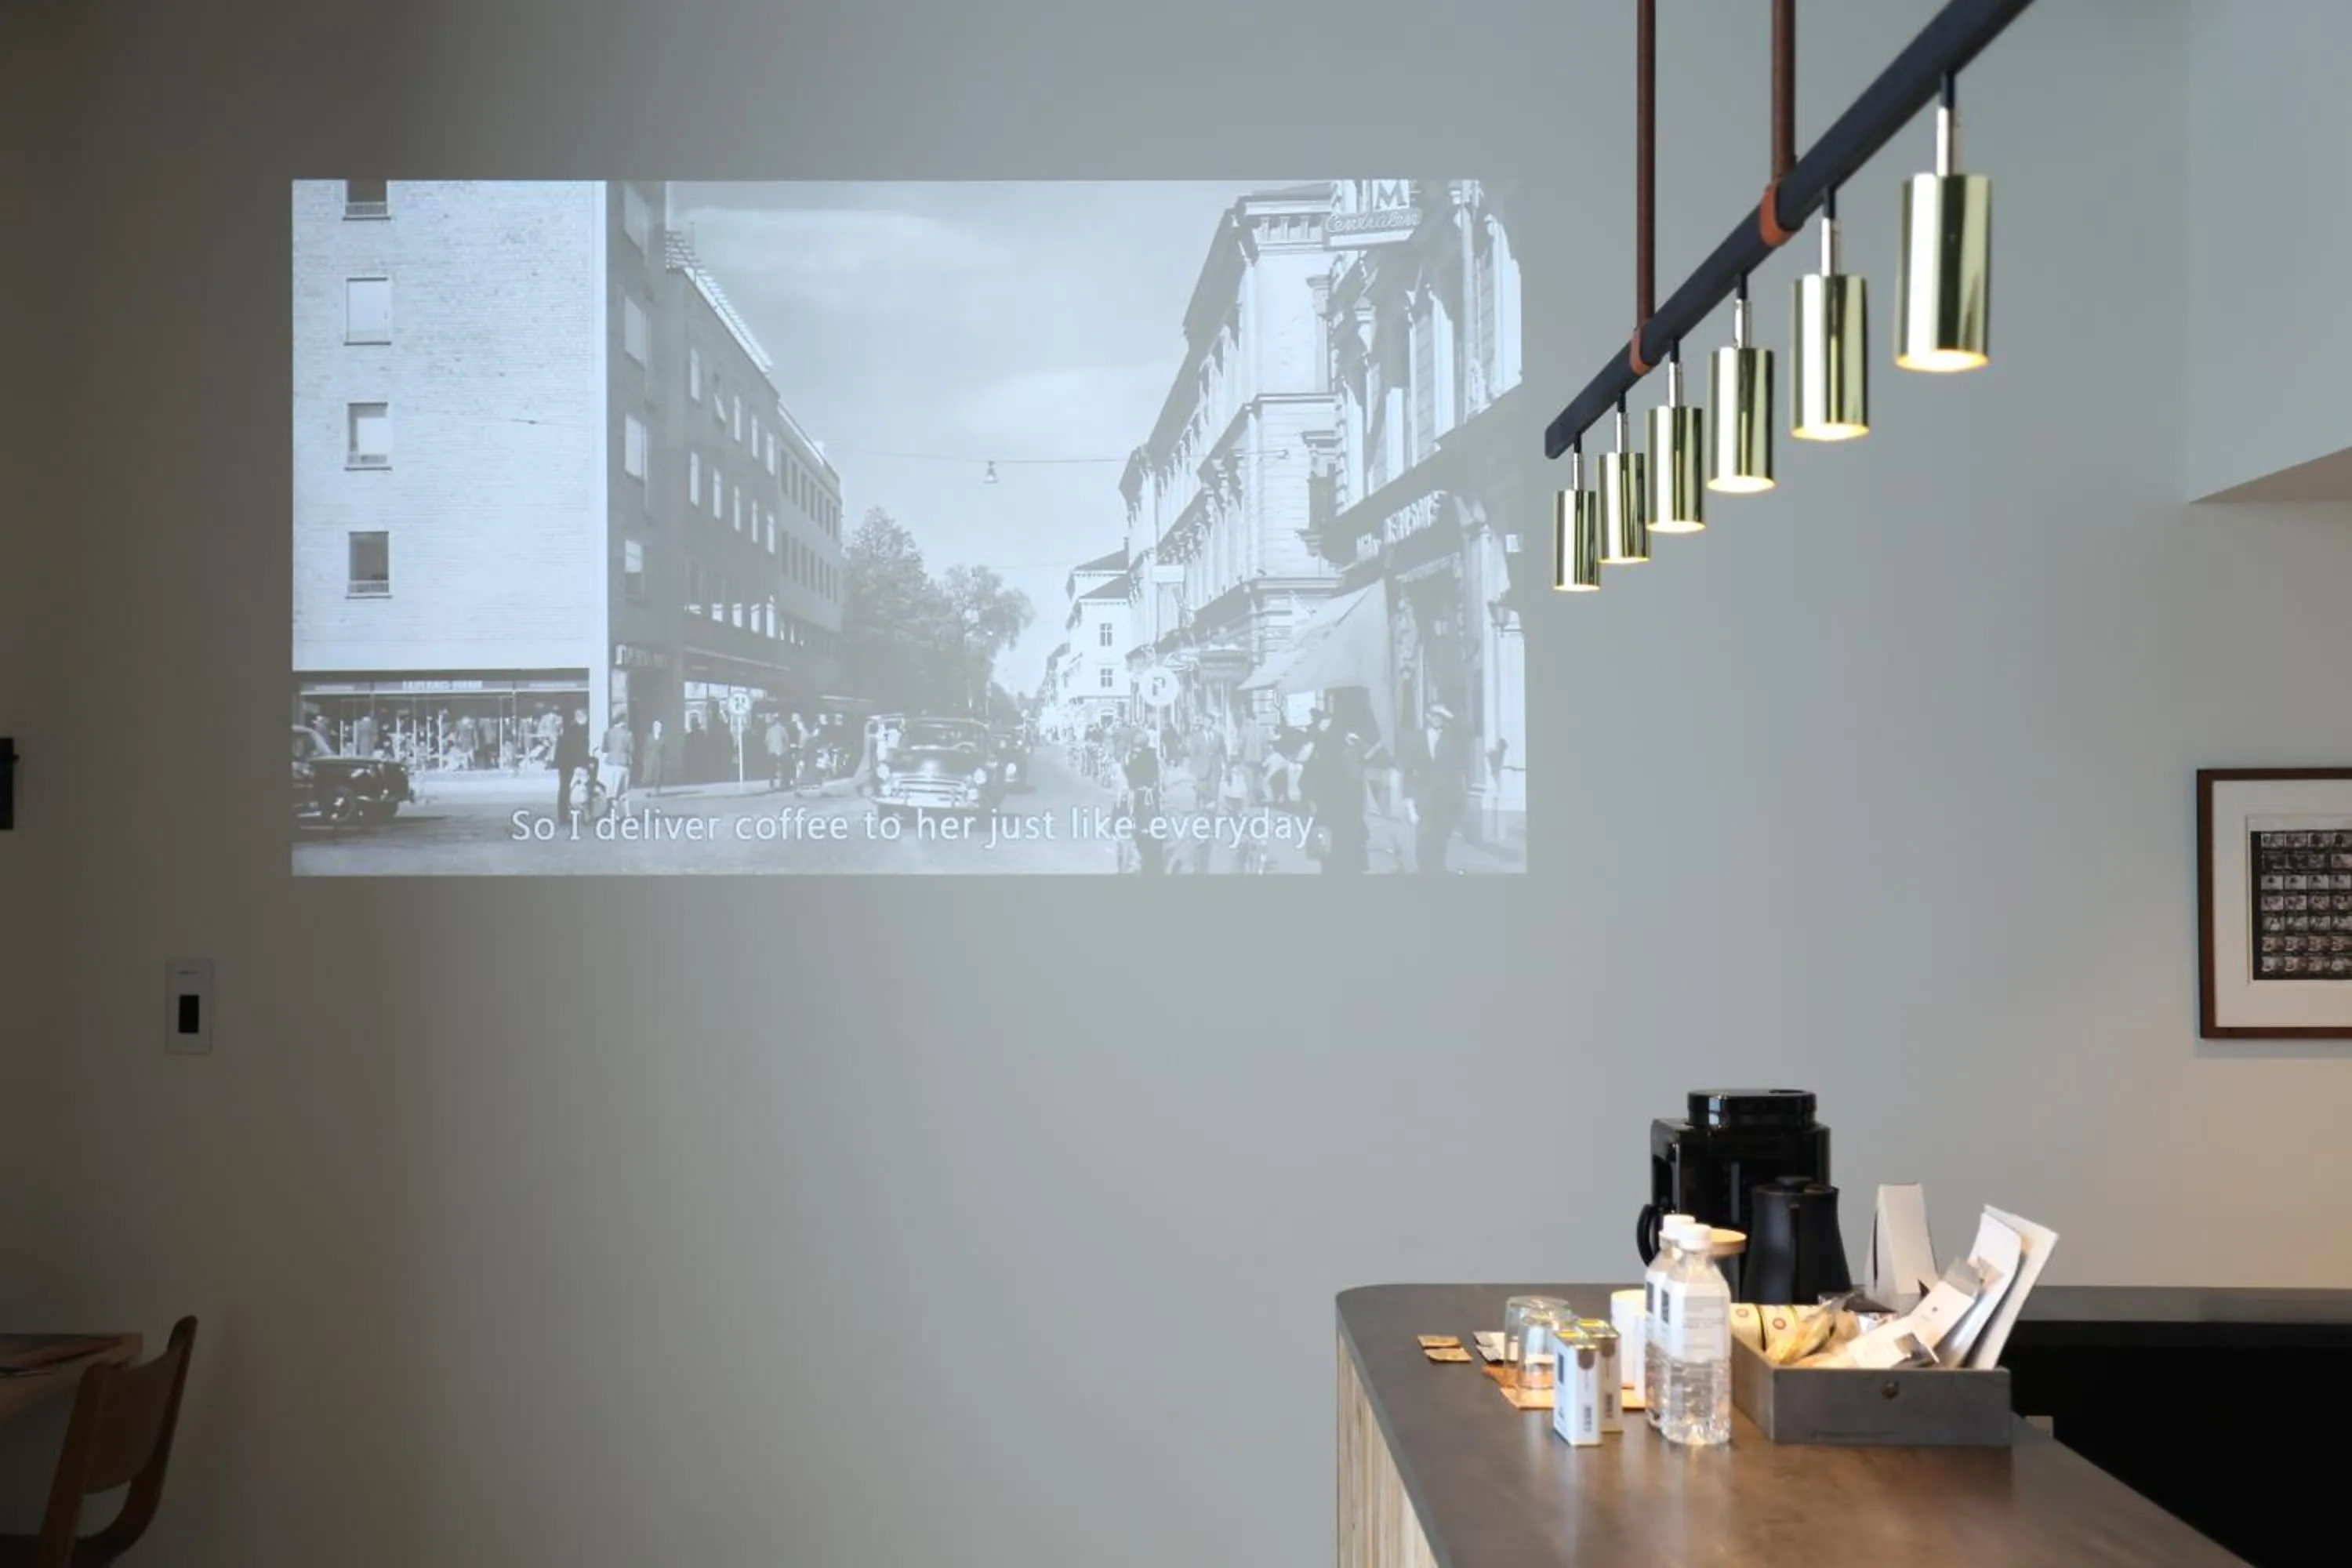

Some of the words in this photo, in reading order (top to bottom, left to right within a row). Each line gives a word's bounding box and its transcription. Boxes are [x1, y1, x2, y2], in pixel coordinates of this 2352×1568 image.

[511, 809, 555, 841] So
[569, 809, 582, 841] I
[594, 808, 720, 841] deliver
[735, 807, 848, 840] coffee
[864, 811, 901, 840] to
[916, 808, 978, 840] her
[984, 808, 1058, 849] just
[1071, 807, 1133, 841] like
[1149, 806, 1323, 849] everyday.
